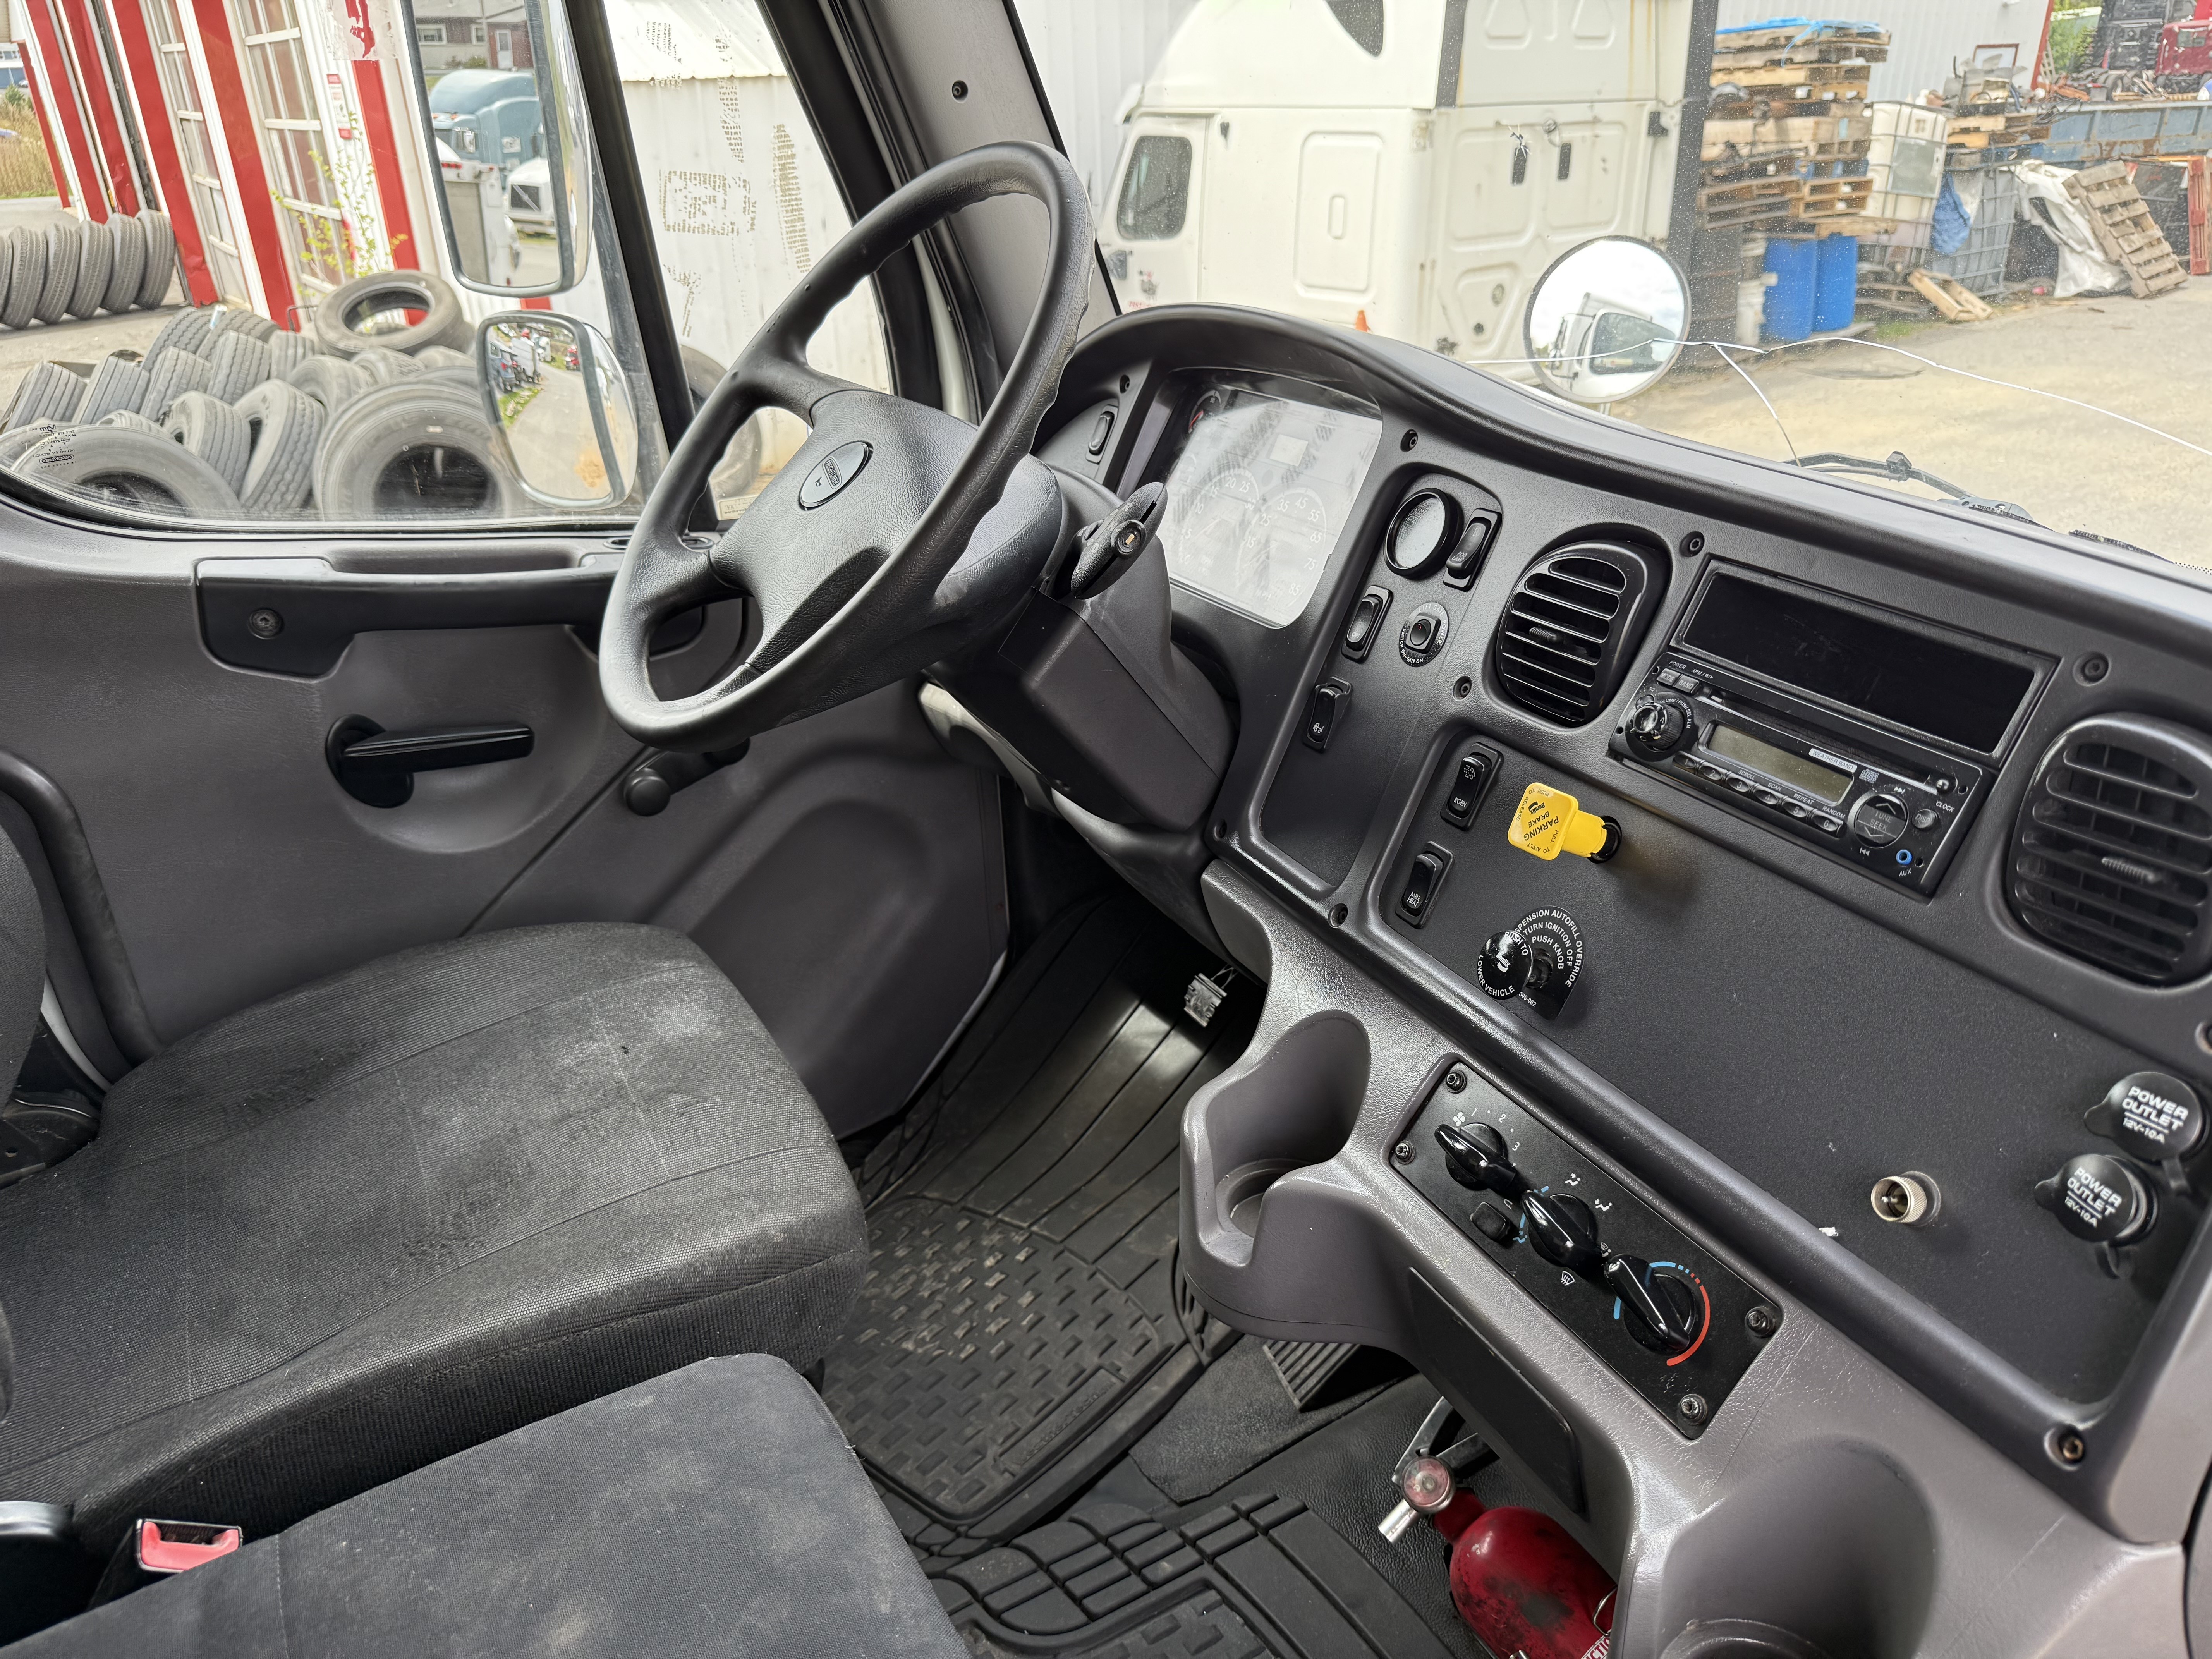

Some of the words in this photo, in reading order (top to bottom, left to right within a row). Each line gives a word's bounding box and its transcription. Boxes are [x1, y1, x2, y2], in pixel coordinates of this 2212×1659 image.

[1224, 477, 1236, 488] 20
[1239, 481, 1250, 493] 25
[1277, 499, 1290, 512] 35
[1295, 497, 1308, 509] 45
[1260, 514, 1271, 526] 25
[1307, 510, 1320, 522] 55
[1310, 531, 1322, 543] 65
[1304, 558, 1316, 570] 75
[1288, 583, 1301, 596] 85
[1419, 604, 1432, 612] LIFT
[1433, 605, 1444, 617] GATE
[1437, 620, 1446, 644] POWER
[1669, 660, 1686, 670] POWER
[1661, 672, 1675, 682] MODE
[1678, 680, 1694, 690] BAND
[1678, 700, 1689, 709] PUSH
[1812, 750, 1838, 764] WEATHER
[1838, 760, 1853, 770] BAND
[1738, 770, 1755, 781] SCROLL
[1537, 788, 1549, 797] PUSH
[1767, 782, 1782, 792] SCAN
[1453, 797, 1467, 808] RGEN
[1793, 793, 1814, 805] REPEAT
[1516, 797, 1529, 821] RELEASE
[1529, 802, 1545, 815] Bendix
[1822, 806, 1846, 819] RANDOM
[1936, 801, 1955, 812] CLOCK
[1528, 811, 1549, 828] BRAKE
[1875, 811, 1893, 824] TUNE
[1915, 813, 1933, 823] DISP
[1523, 816, 1559, 841] PARKING
[1823, 820, 1830, 828] 6
[1870, 819, 1889, 831] SEEK
[1550, 830, 1559, 843] PULL
[1527, 843, 1541, 852] APPLY
[1899, 868, 1911, 877] AUX
[1407, 896, 1419, 907] HEAT
[1515, 909, 1549, 933] SPENSION
[1551, 911, 1580, 939] AUTOFILL
[1523, 922, 1543, 936] TURN
[1545, 922, 1571, 947] IGNITION
[1505, 931, 1523, 945] PUSH
[1520, 943, 1528, 956] TO
[1532, 935, 1553, 945] PUSH
[1553, 943, 1564, 969] KNOB
[1496, 952, 1510, 968] Bendix
[1565, 940, 1583, 987] OVERRIDE
[1485, 985, 1515, 997] VEHICLE
[2128, 1086, 2188, 1120] POWER
[1471, 1108, 1477, 1116] 1
[1498, 1113, 1506, 1123] 2
[2122, 1098, 2184, 1131] OUTLET
[2123, 1117, 2165, 1144] 12V-10A
[1512, 1141, 1520, 1151] 3
[2074, 1166, 2122, 1207] POWER
[2067, 1177, 2116, 1216] OUTLET
[2064, 1196, 2097, 1228] 12V-10A
